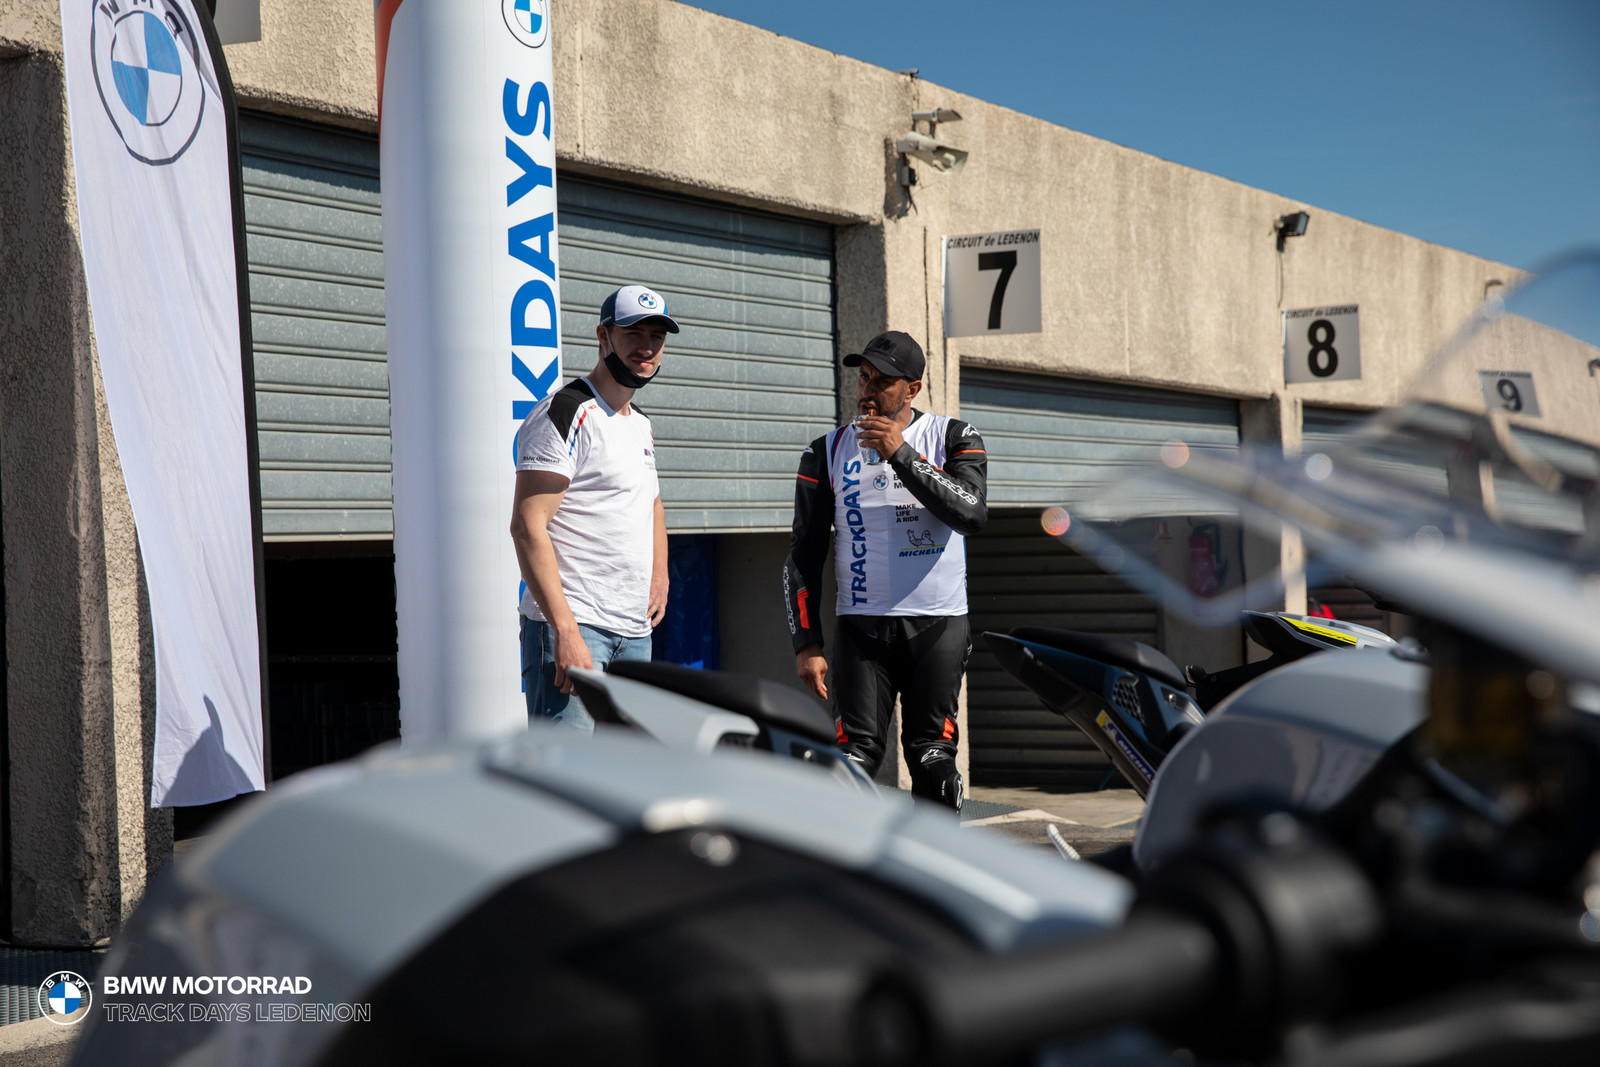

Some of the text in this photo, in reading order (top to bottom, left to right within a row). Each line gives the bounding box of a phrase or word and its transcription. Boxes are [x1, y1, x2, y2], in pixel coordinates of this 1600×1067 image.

[947, 231, 1040, 249] CIRCUIT de LEDENON
[978, 250, 1017, 330] 7
[1307, 319, 1338, 378] 8
[1496, 379, 1523, 413] 9
[843, 460, 868, 606] TRACKDAYS
[899, 547, 945, 557] MICHELIN
